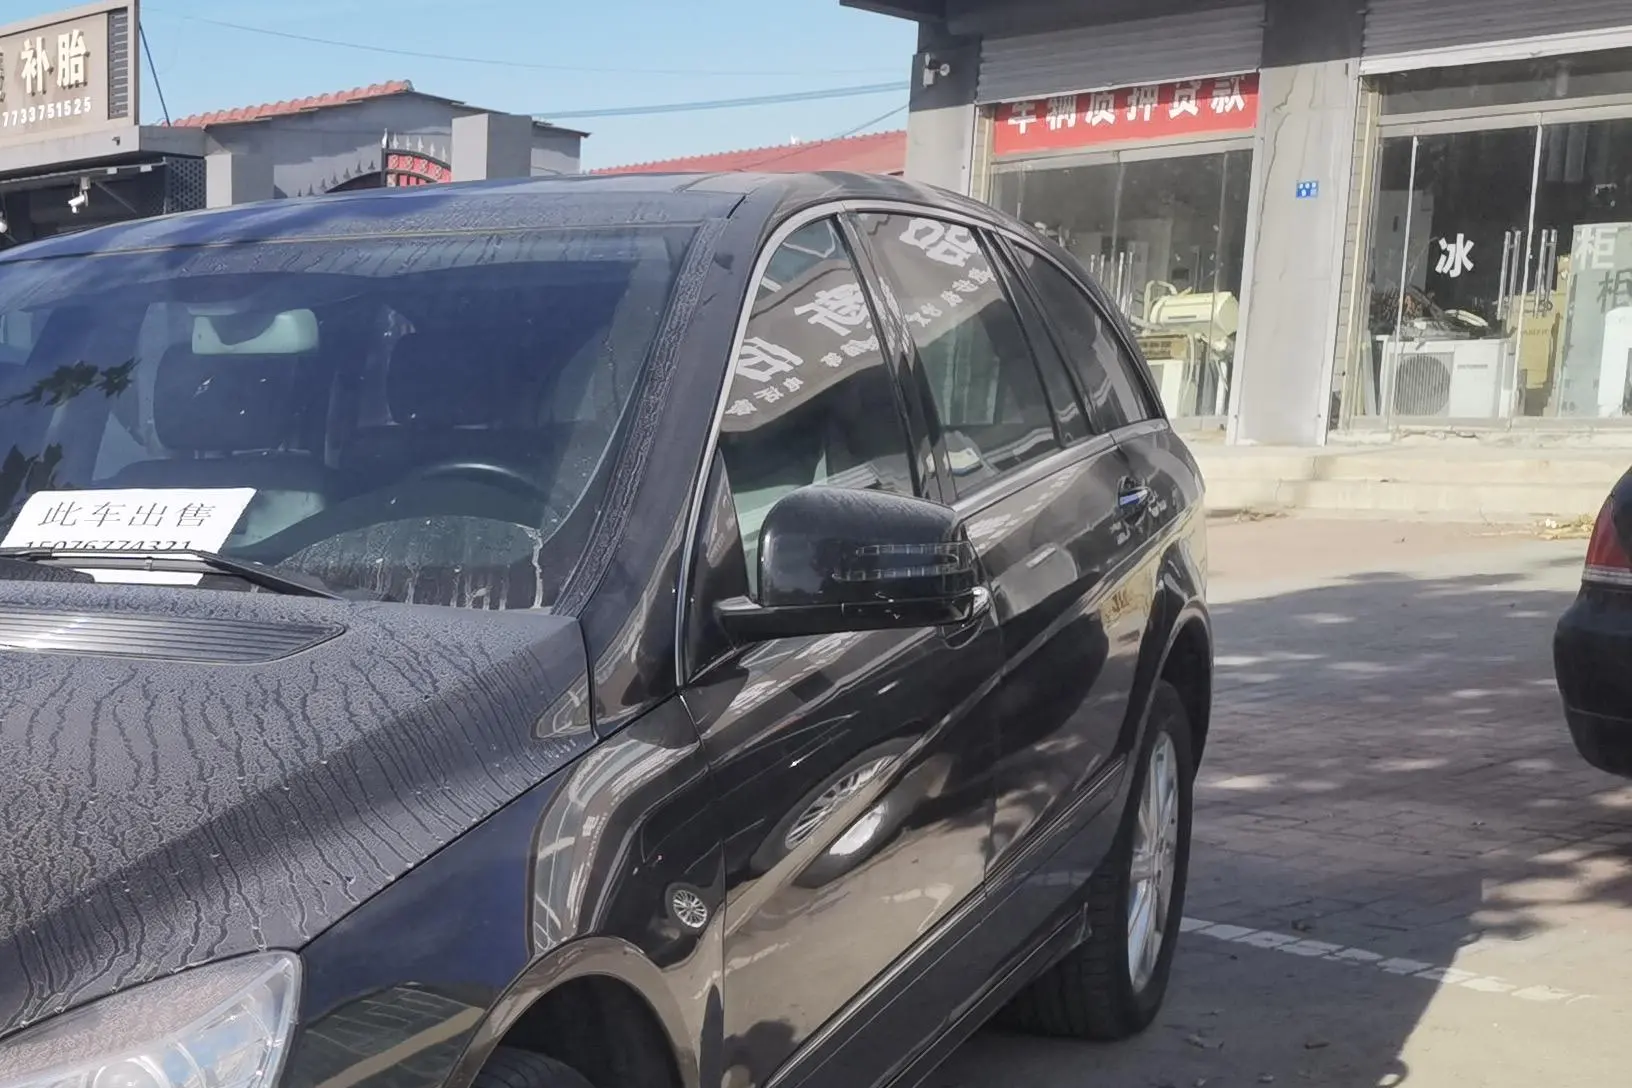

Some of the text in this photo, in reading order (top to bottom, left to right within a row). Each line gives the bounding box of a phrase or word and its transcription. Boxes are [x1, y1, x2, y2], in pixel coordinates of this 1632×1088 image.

[20, 28, 91, 95] 补胎
[1435, 227, 1618, 278] 冰 柜
[37, 500, 216, 528] 此车出售
